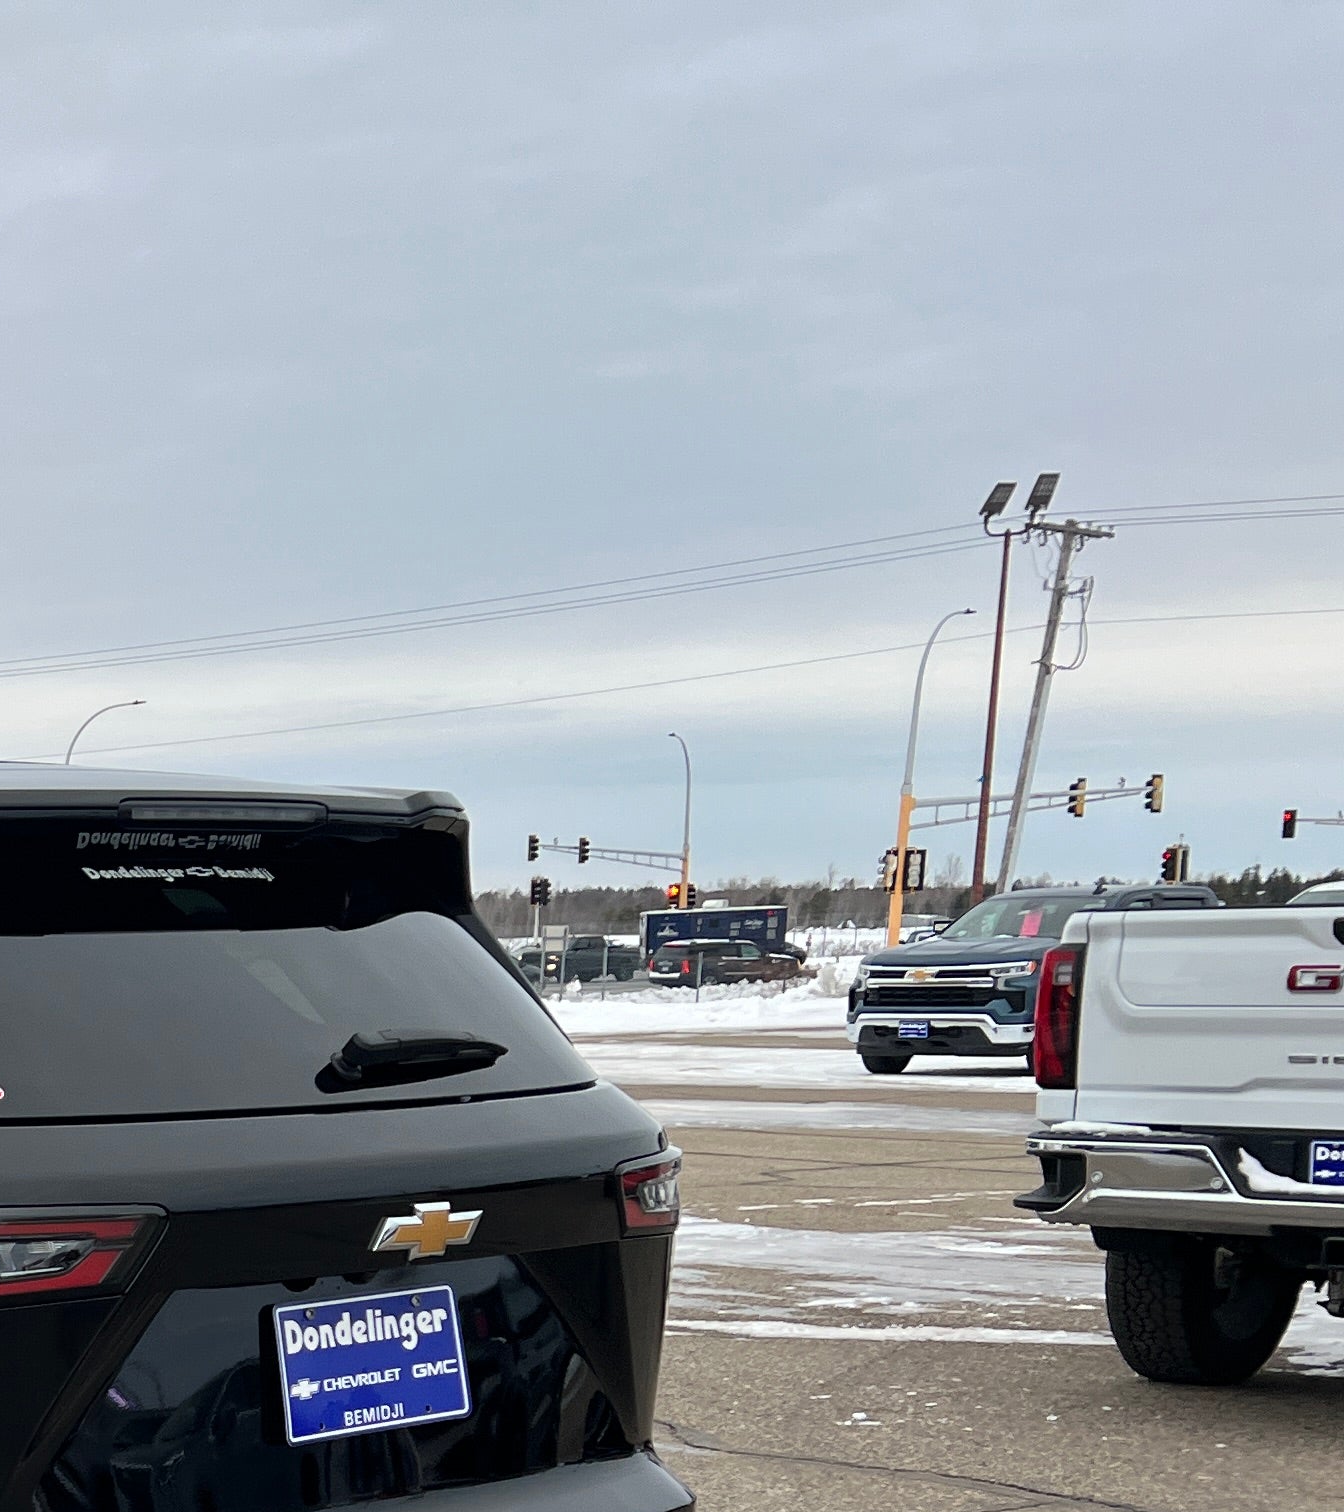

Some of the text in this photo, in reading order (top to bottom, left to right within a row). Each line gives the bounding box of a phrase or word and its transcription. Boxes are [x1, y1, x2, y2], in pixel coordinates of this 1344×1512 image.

[81, 866, 275, 882] Dondelinger Bemidji
[283, 1308, 448, 1355] Dondelinger
[323, 1358, 459, 1392] CHEVROLET GMC
[344, 1402, 405, 1427] BEMIDJI
